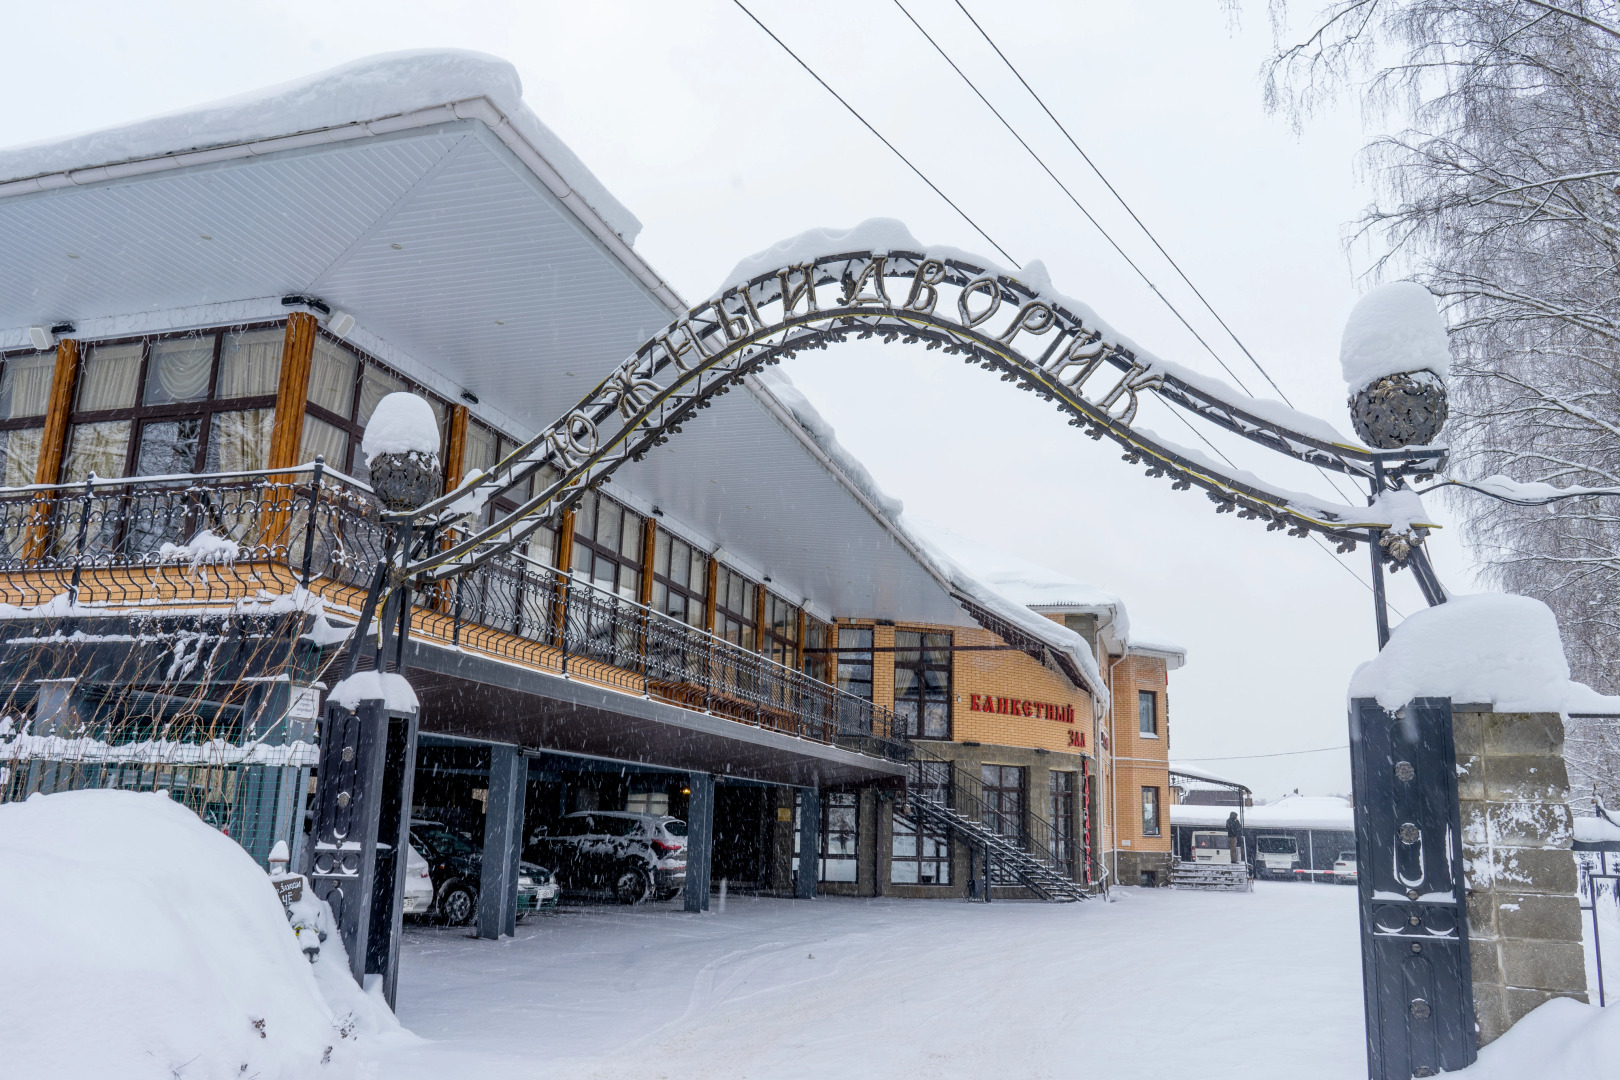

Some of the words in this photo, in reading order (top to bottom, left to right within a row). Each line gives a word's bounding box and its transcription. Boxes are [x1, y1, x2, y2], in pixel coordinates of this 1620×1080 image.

[543, 262, 820, 475] ЮЖНЫЙ
[849, 256, 1164, 428] ДВОРИК
[970, 693, 1075, 724] БАНКЕТНЫЙ
[1068, 729, 1086, 748] ЗАЛ
[1083, 760, 1092, 884] КАРАОКЕ
